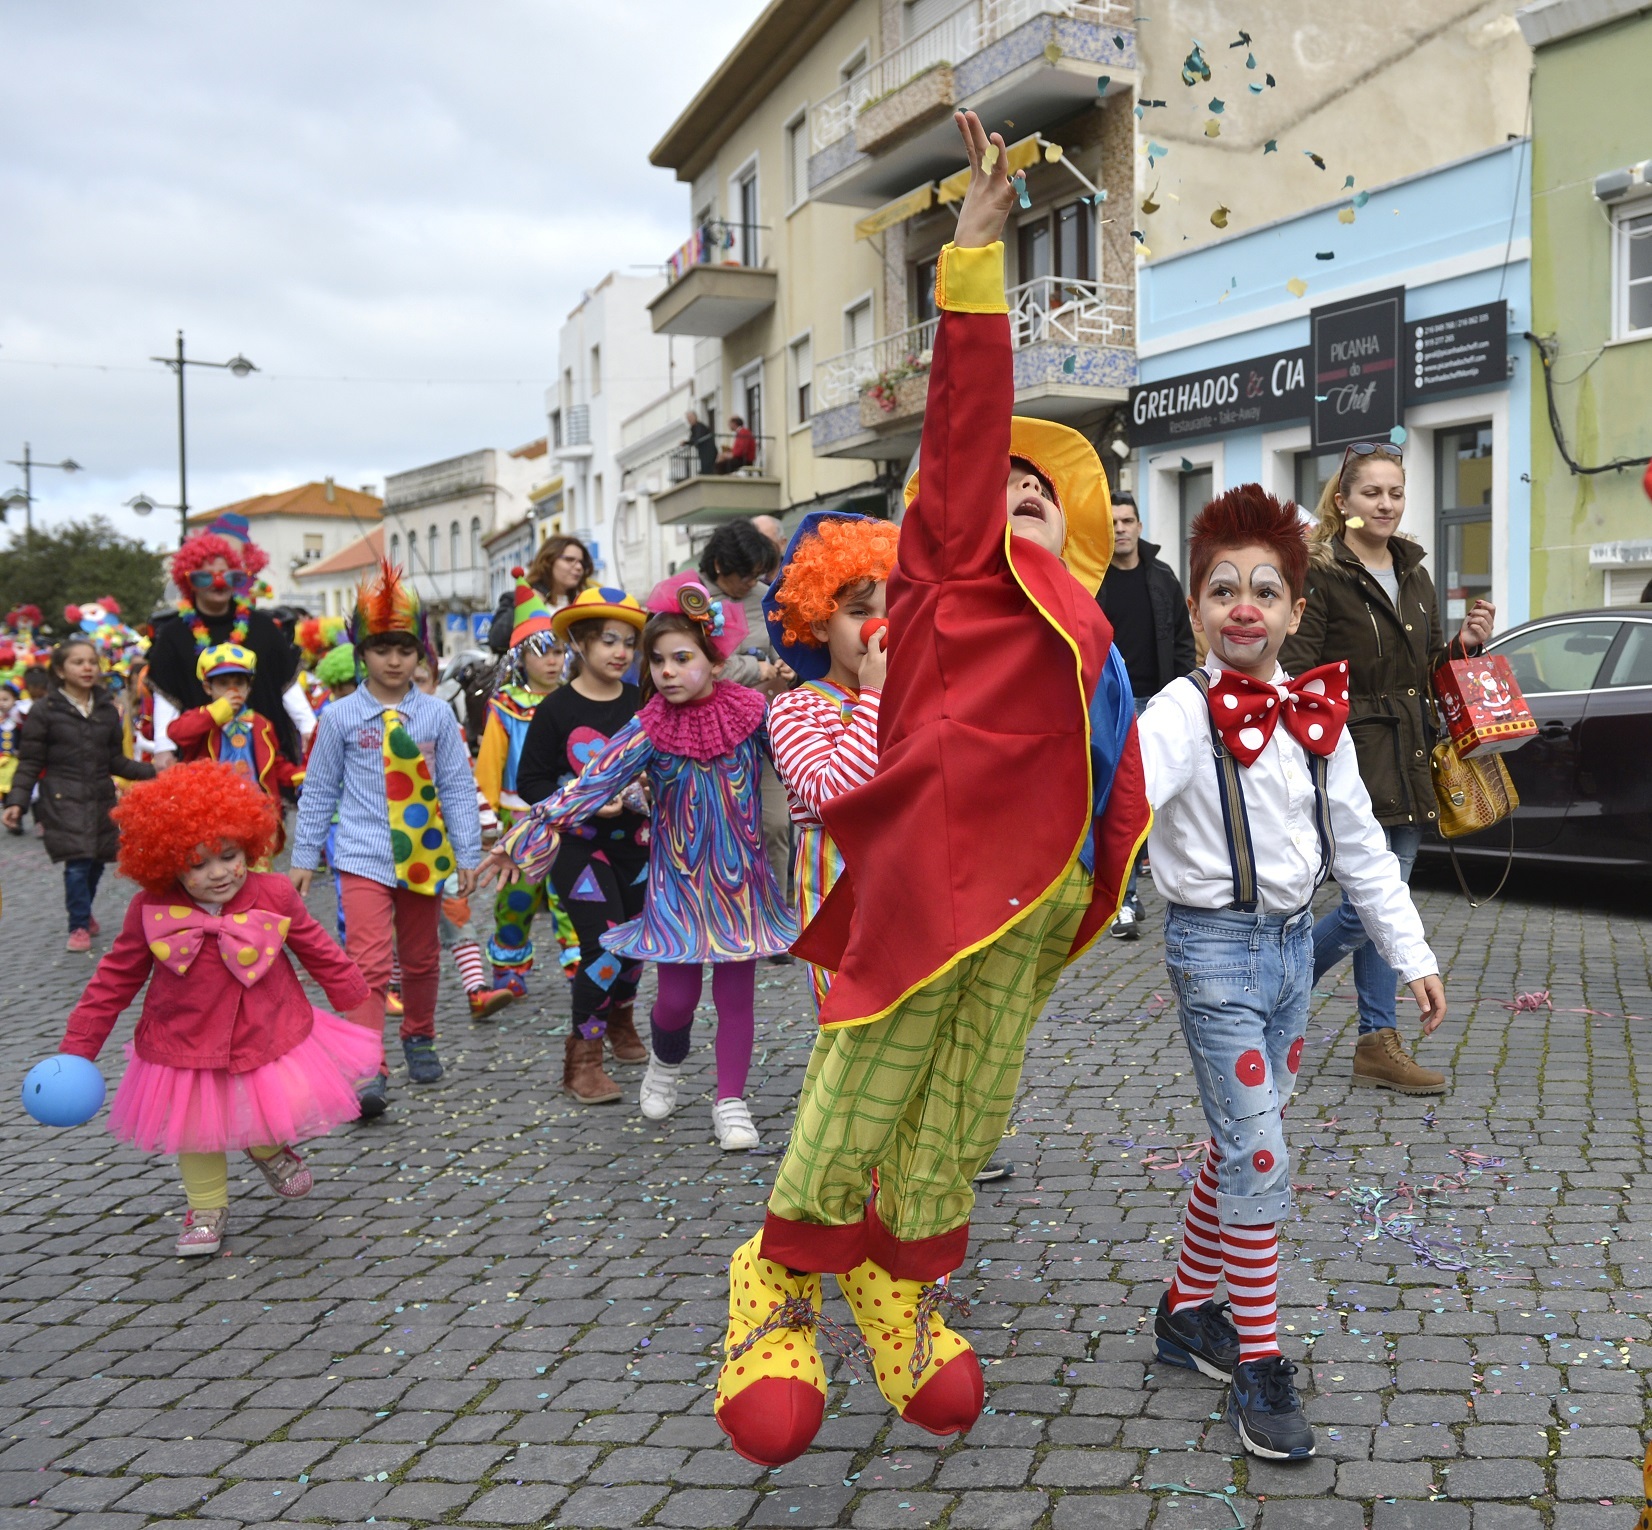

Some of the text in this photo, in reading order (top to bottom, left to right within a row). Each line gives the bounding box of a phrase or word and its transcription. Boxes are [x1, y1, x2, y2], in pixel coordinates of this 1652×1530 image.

[1330, 334, 1380, 363] PICANHA
[1349, 362, 1361, 377] do
[1133, 372, 1240, 425] GRELHADOS
[1246, 370, 1264, 398] &
[1169, 406, 1262, 434] Restaurante Take-Away
